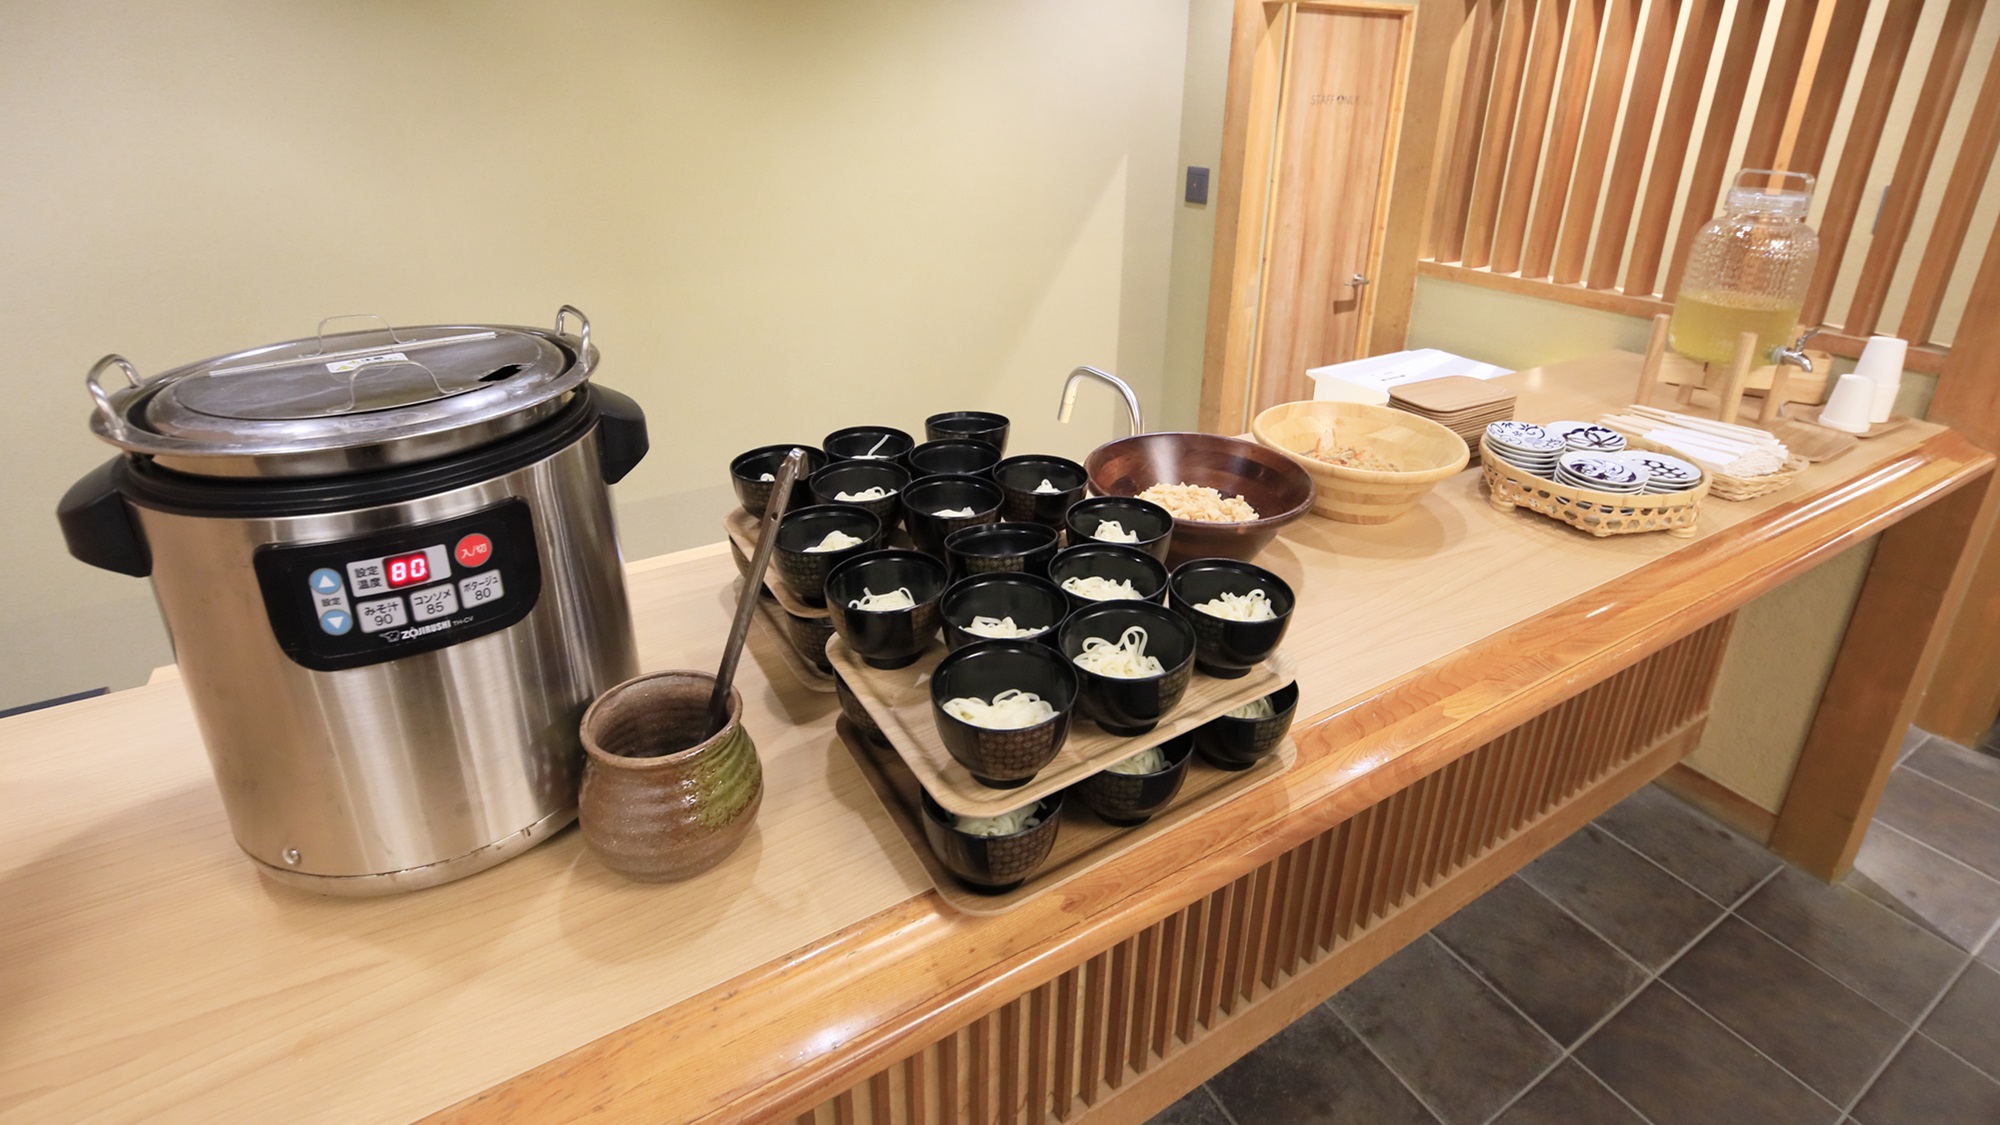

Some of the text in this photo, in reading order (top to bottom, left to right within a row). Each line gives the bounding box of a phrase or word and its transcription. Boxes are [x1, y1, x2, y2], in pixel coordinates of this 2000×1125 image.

[1311, 94, 1360, 105] STAFF ONLY
[461, 543, 487, 559] 入/切
[354, 566, 379, 578] 設定
[392, 558, 426, 581] 80
[357, 578, 382, 589] 温度
[464, 576, 498, 592] ポタージュ
[414, 589, 451, 606] コンソメ
[475, 587, 491, 600] 80
[321, 597, 341, 607] 設定
[426, 602, 444, 615] 85
[364, 602, 398, 616] みそ汁
[374, 614, 393, 626] 90
[400, 616, 474, 639] ZOJIRUSHI TH-CV
